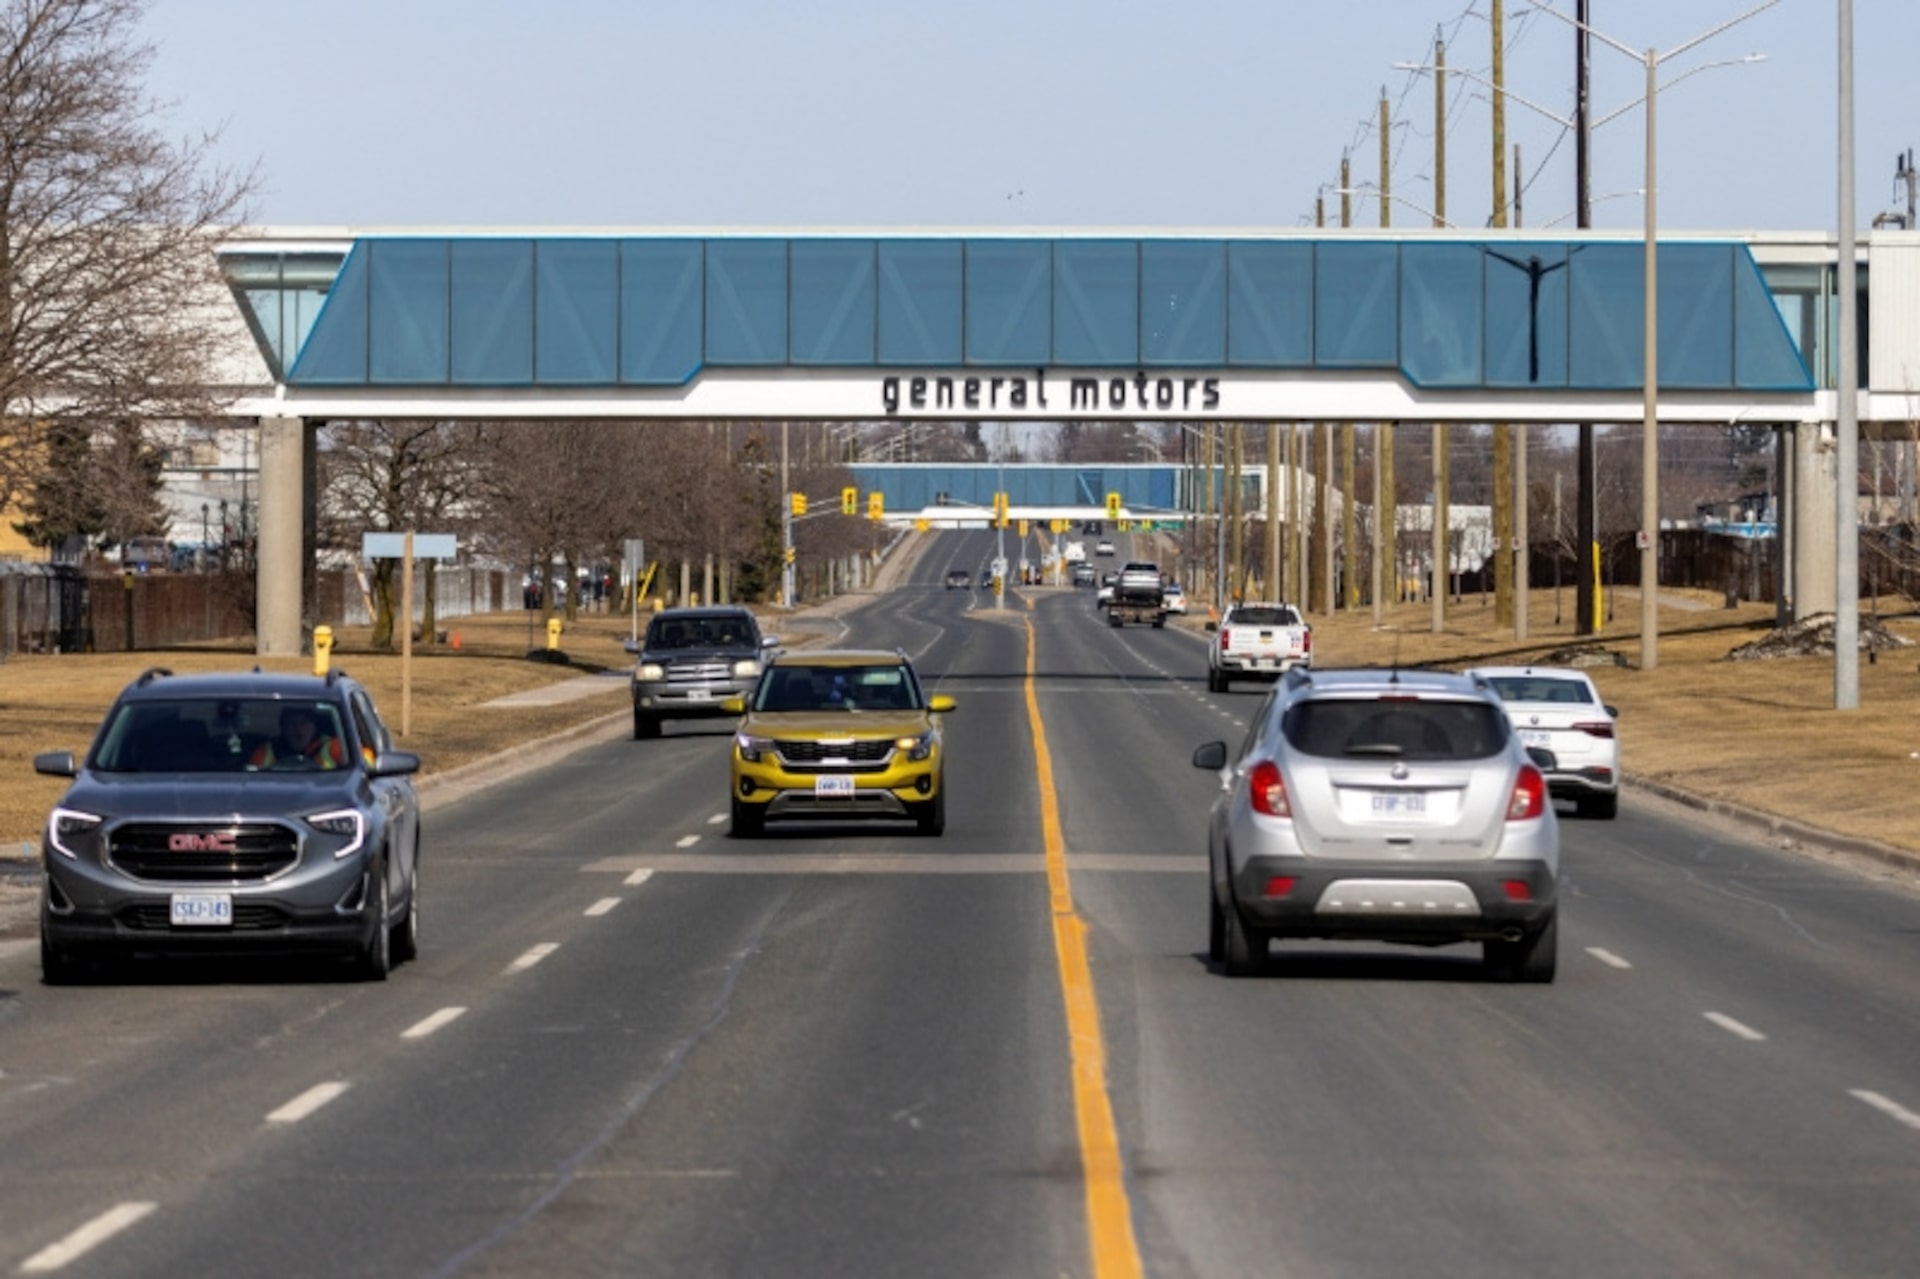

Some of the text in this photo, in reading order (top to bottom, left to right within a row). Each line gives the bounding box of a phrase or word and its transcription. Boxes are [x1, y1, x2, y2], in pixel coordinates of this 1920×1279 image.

[882, 369, 1220, 415] general motors
[169, 833, 237, 852] GMC
